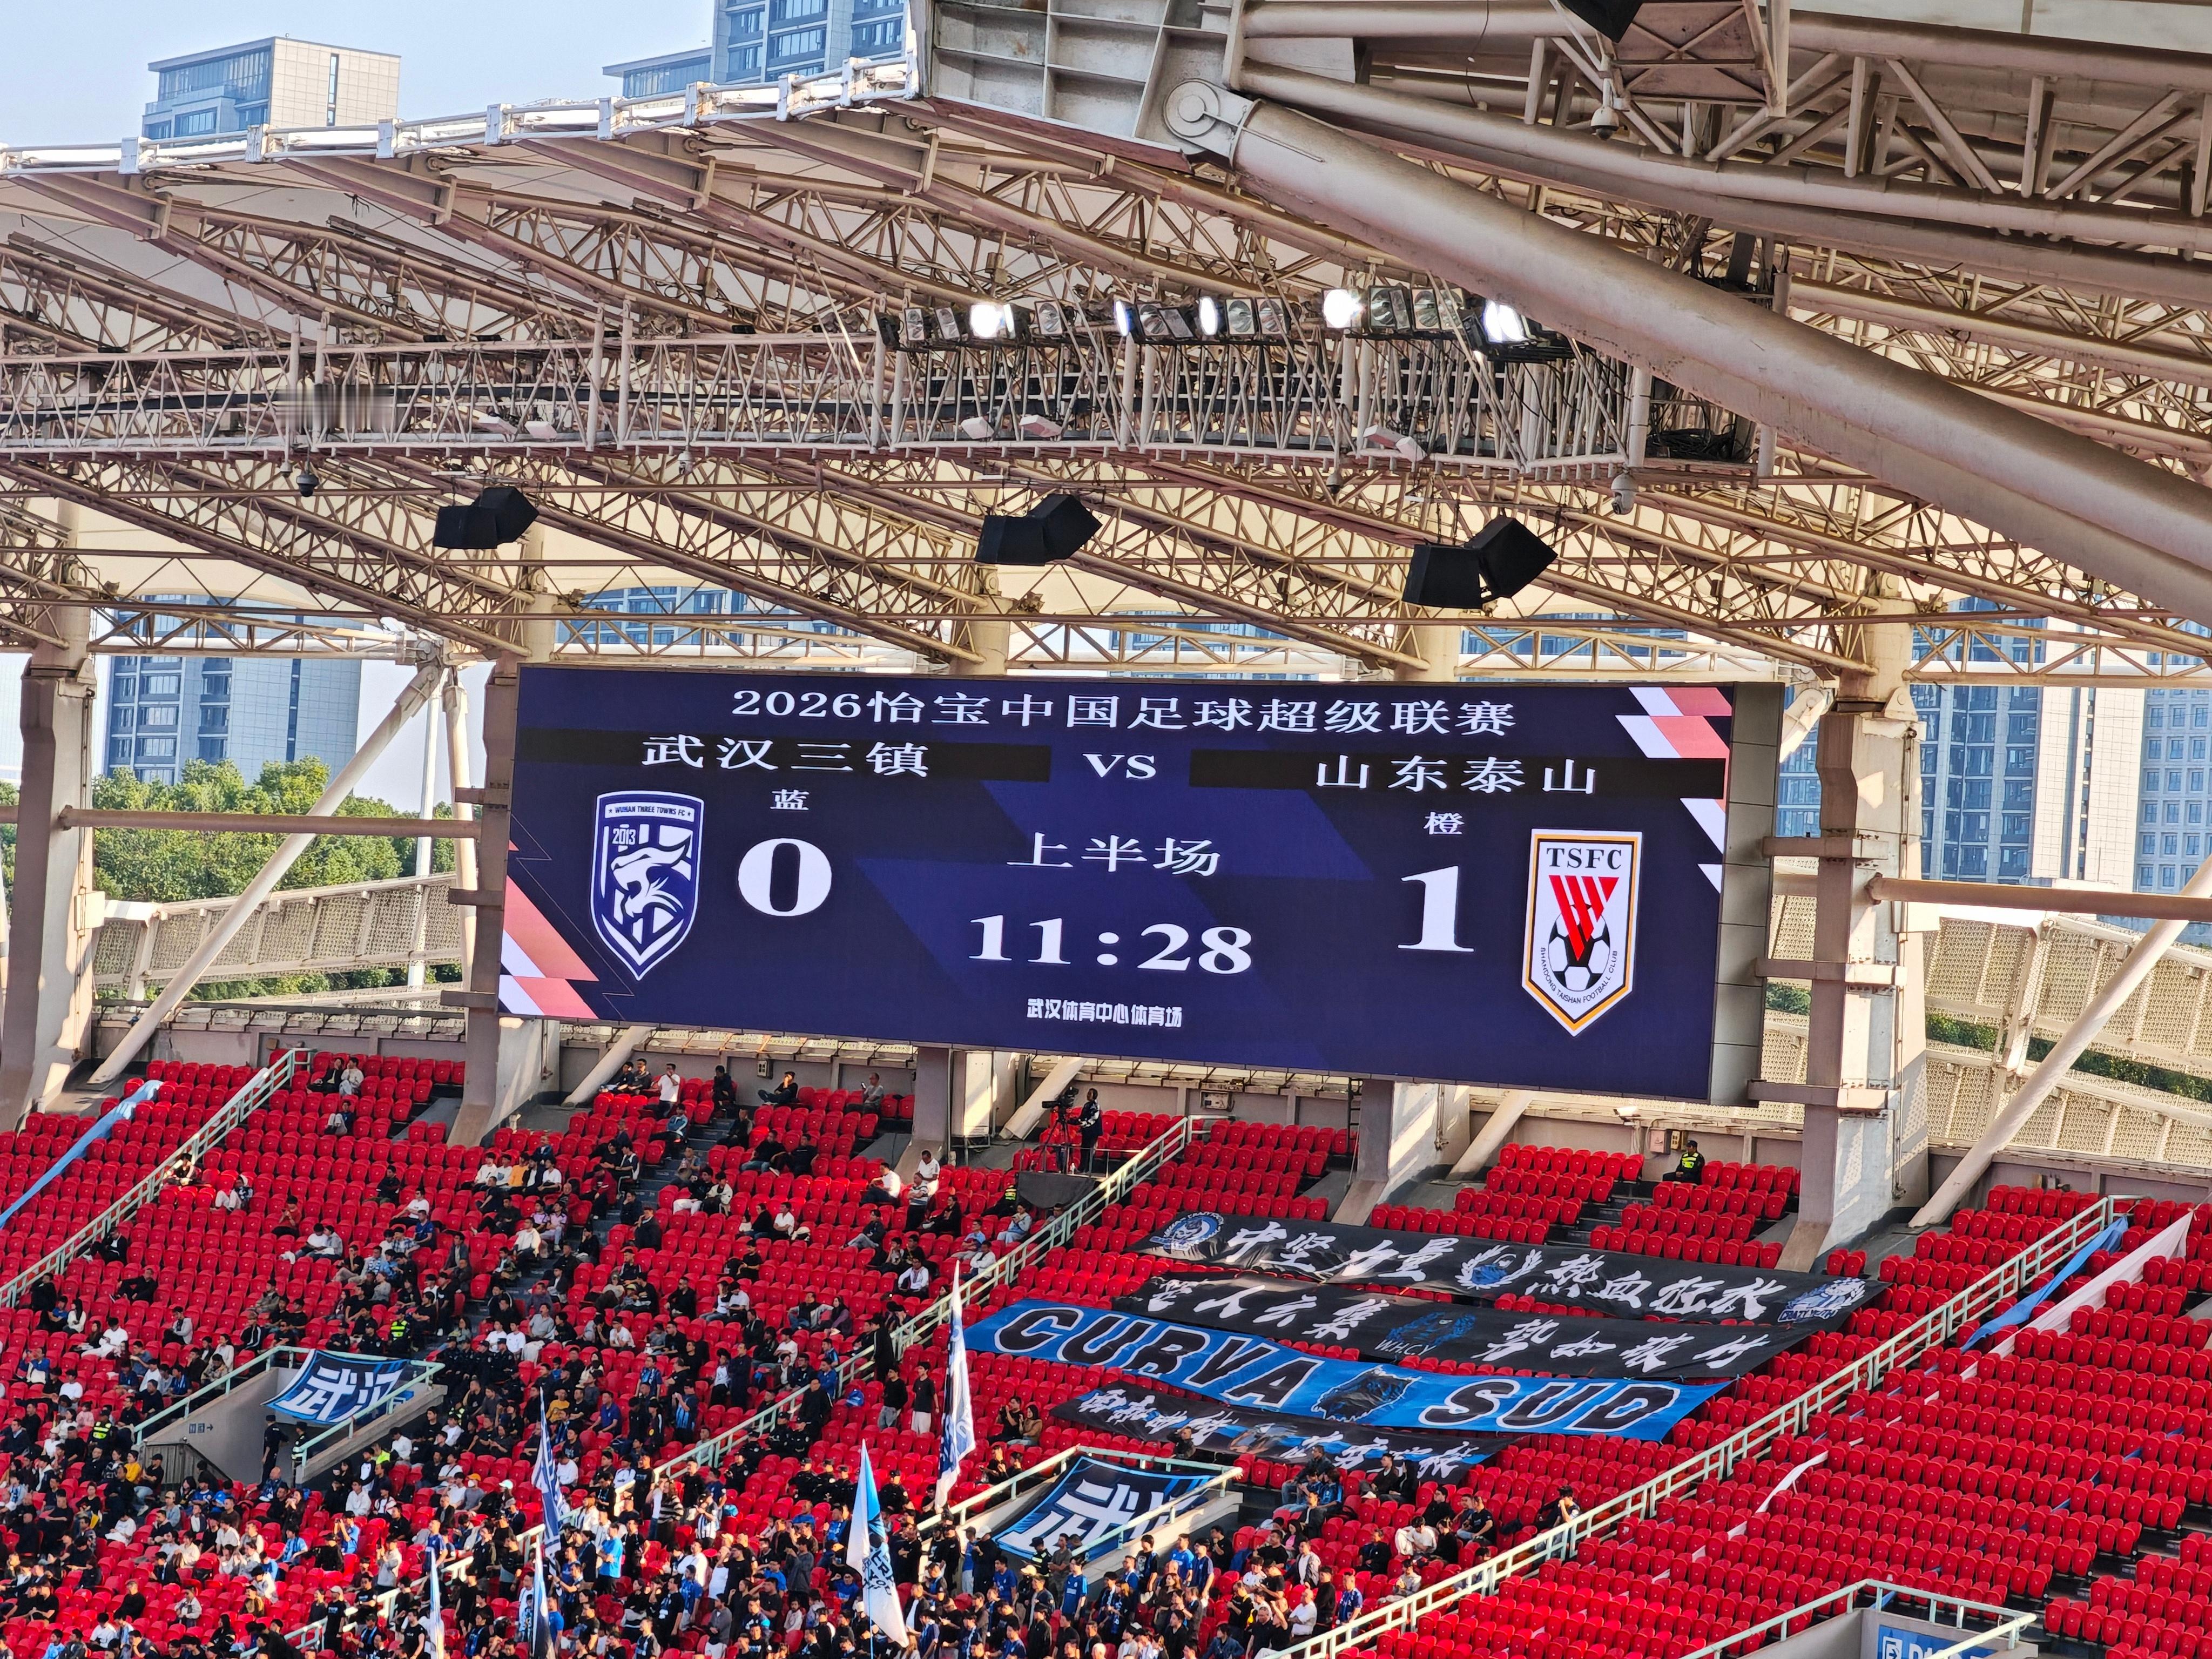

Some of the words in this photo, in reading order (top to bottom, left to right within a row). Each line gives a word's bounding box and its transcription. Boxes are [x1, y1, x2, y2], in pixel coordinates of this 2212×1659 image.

[731, 690, 1516, 737] 2026怡宝中国足球超级联赛
[641, 734, 929, 778] 武汉三镇
[1316, 754, 1596, 795] 山东泰山
[657, 806, 676, 815] TOWNS
[770, 789, 810, 811] 蓝
[612, 827, 636, 845] 2013
[1423, 811, 1464, 835] 橙
[1007, 832, 1220, 876] 上半场
[1546, 848, 1622, 870] TSFC
[738, 838, 832, 916] 0
[1398, 866, 1474, 952] 1
[968, 914, 1252, 974] 11:28
[1540, 947, 1556, 992] SHANDONG
[1557, 989, 1581, 1004] TAISHAN
[1583, 976, 1611, 1003] FOOTBALL
[1608, 950, 1618, 974] CLUB
[1027, 998, 1182, 1028] 武汉体育中心体育场
[994, 1306, 1325, 1409] CURVA
[1418, 1378, 1681, 1433] SUD
